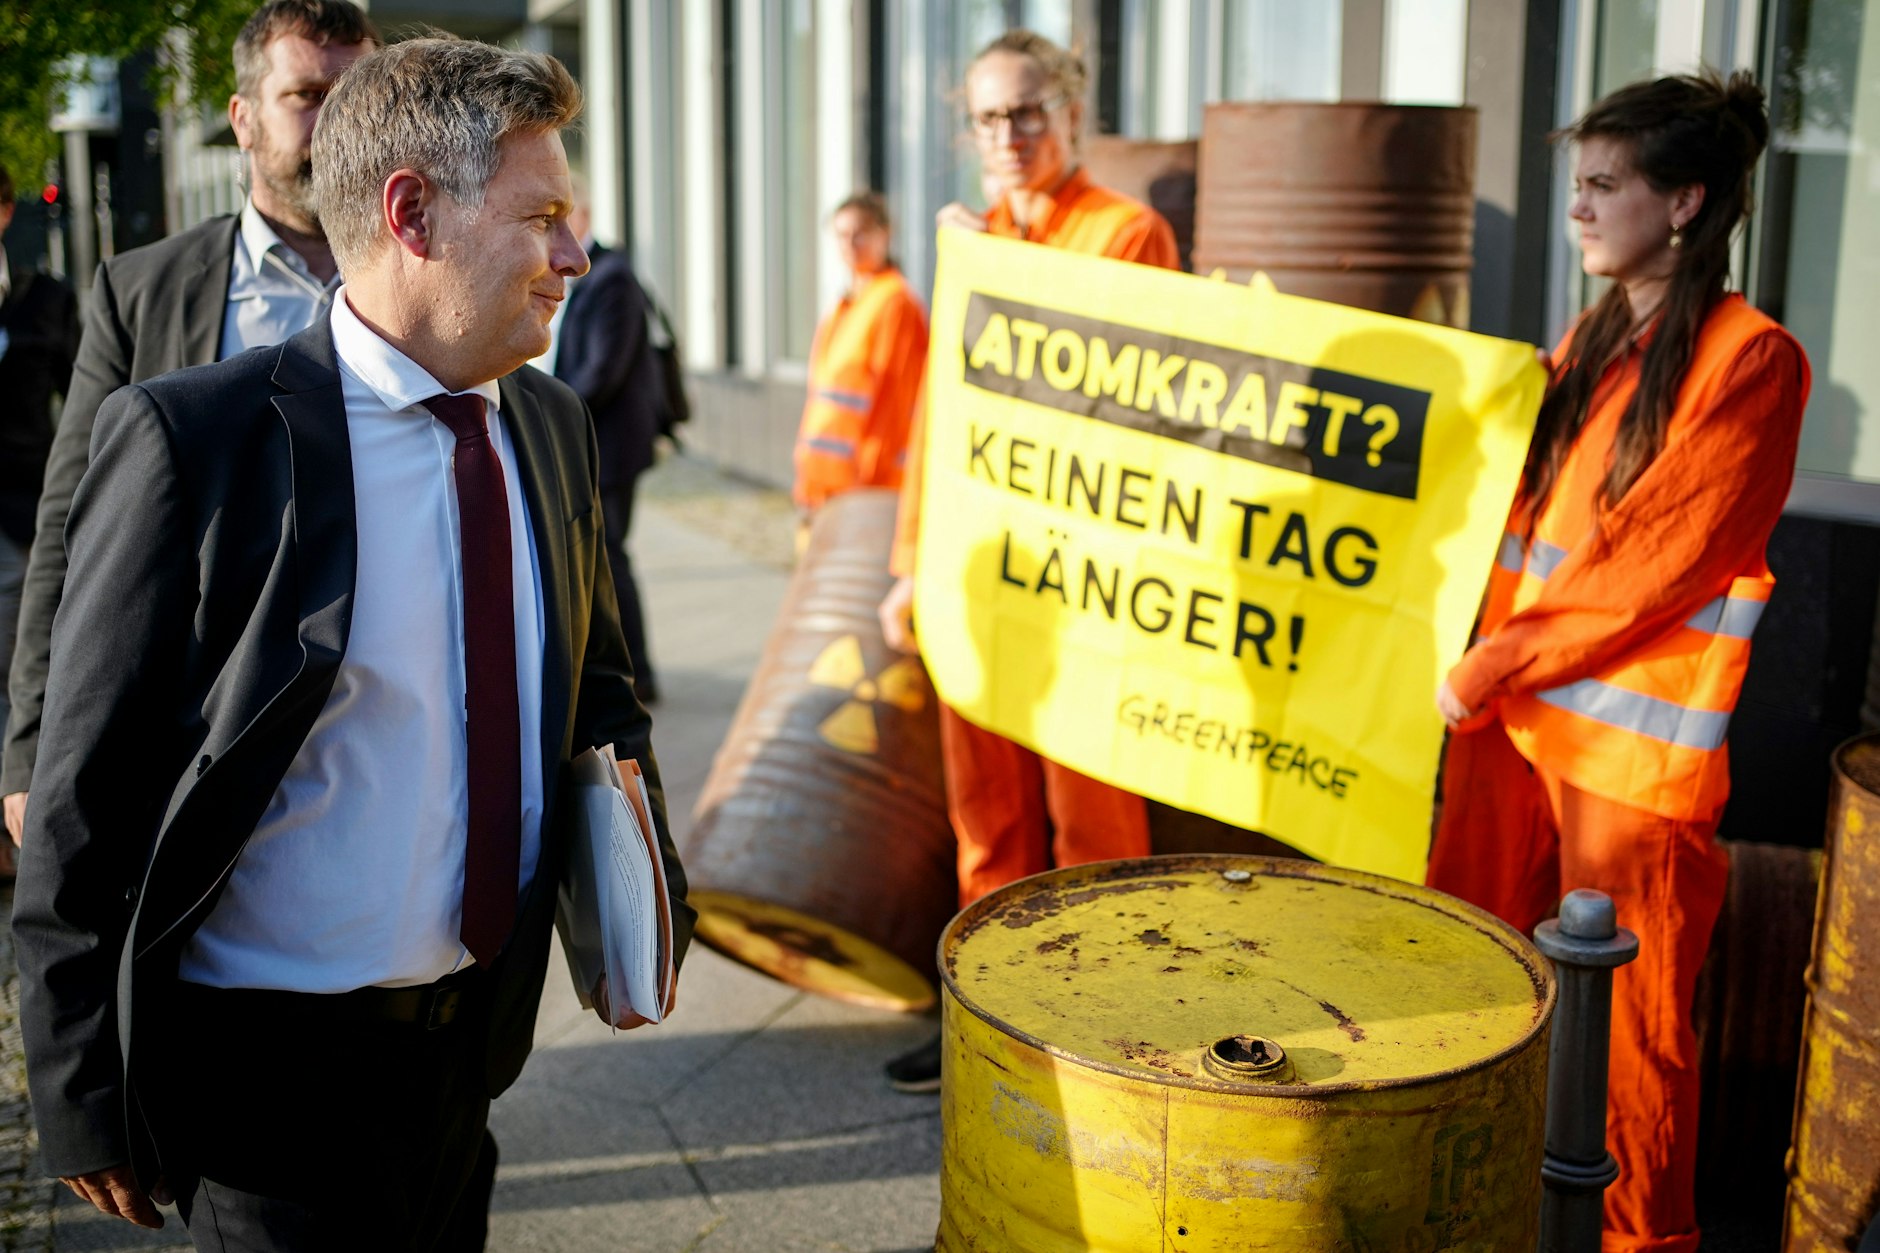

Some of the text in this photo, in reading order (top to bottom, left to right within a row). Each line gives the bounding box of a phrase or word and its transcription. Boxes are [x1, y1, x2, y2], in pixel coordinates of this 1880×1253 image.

[970, 314, 1400, 467] ATOMKRAFT?
[970, 424, 1379, 587] KEINEN TAG
[999, 530, 1307, 672] LÄNGER!
[1119, 696, 1358, 799] GREENPEACE
